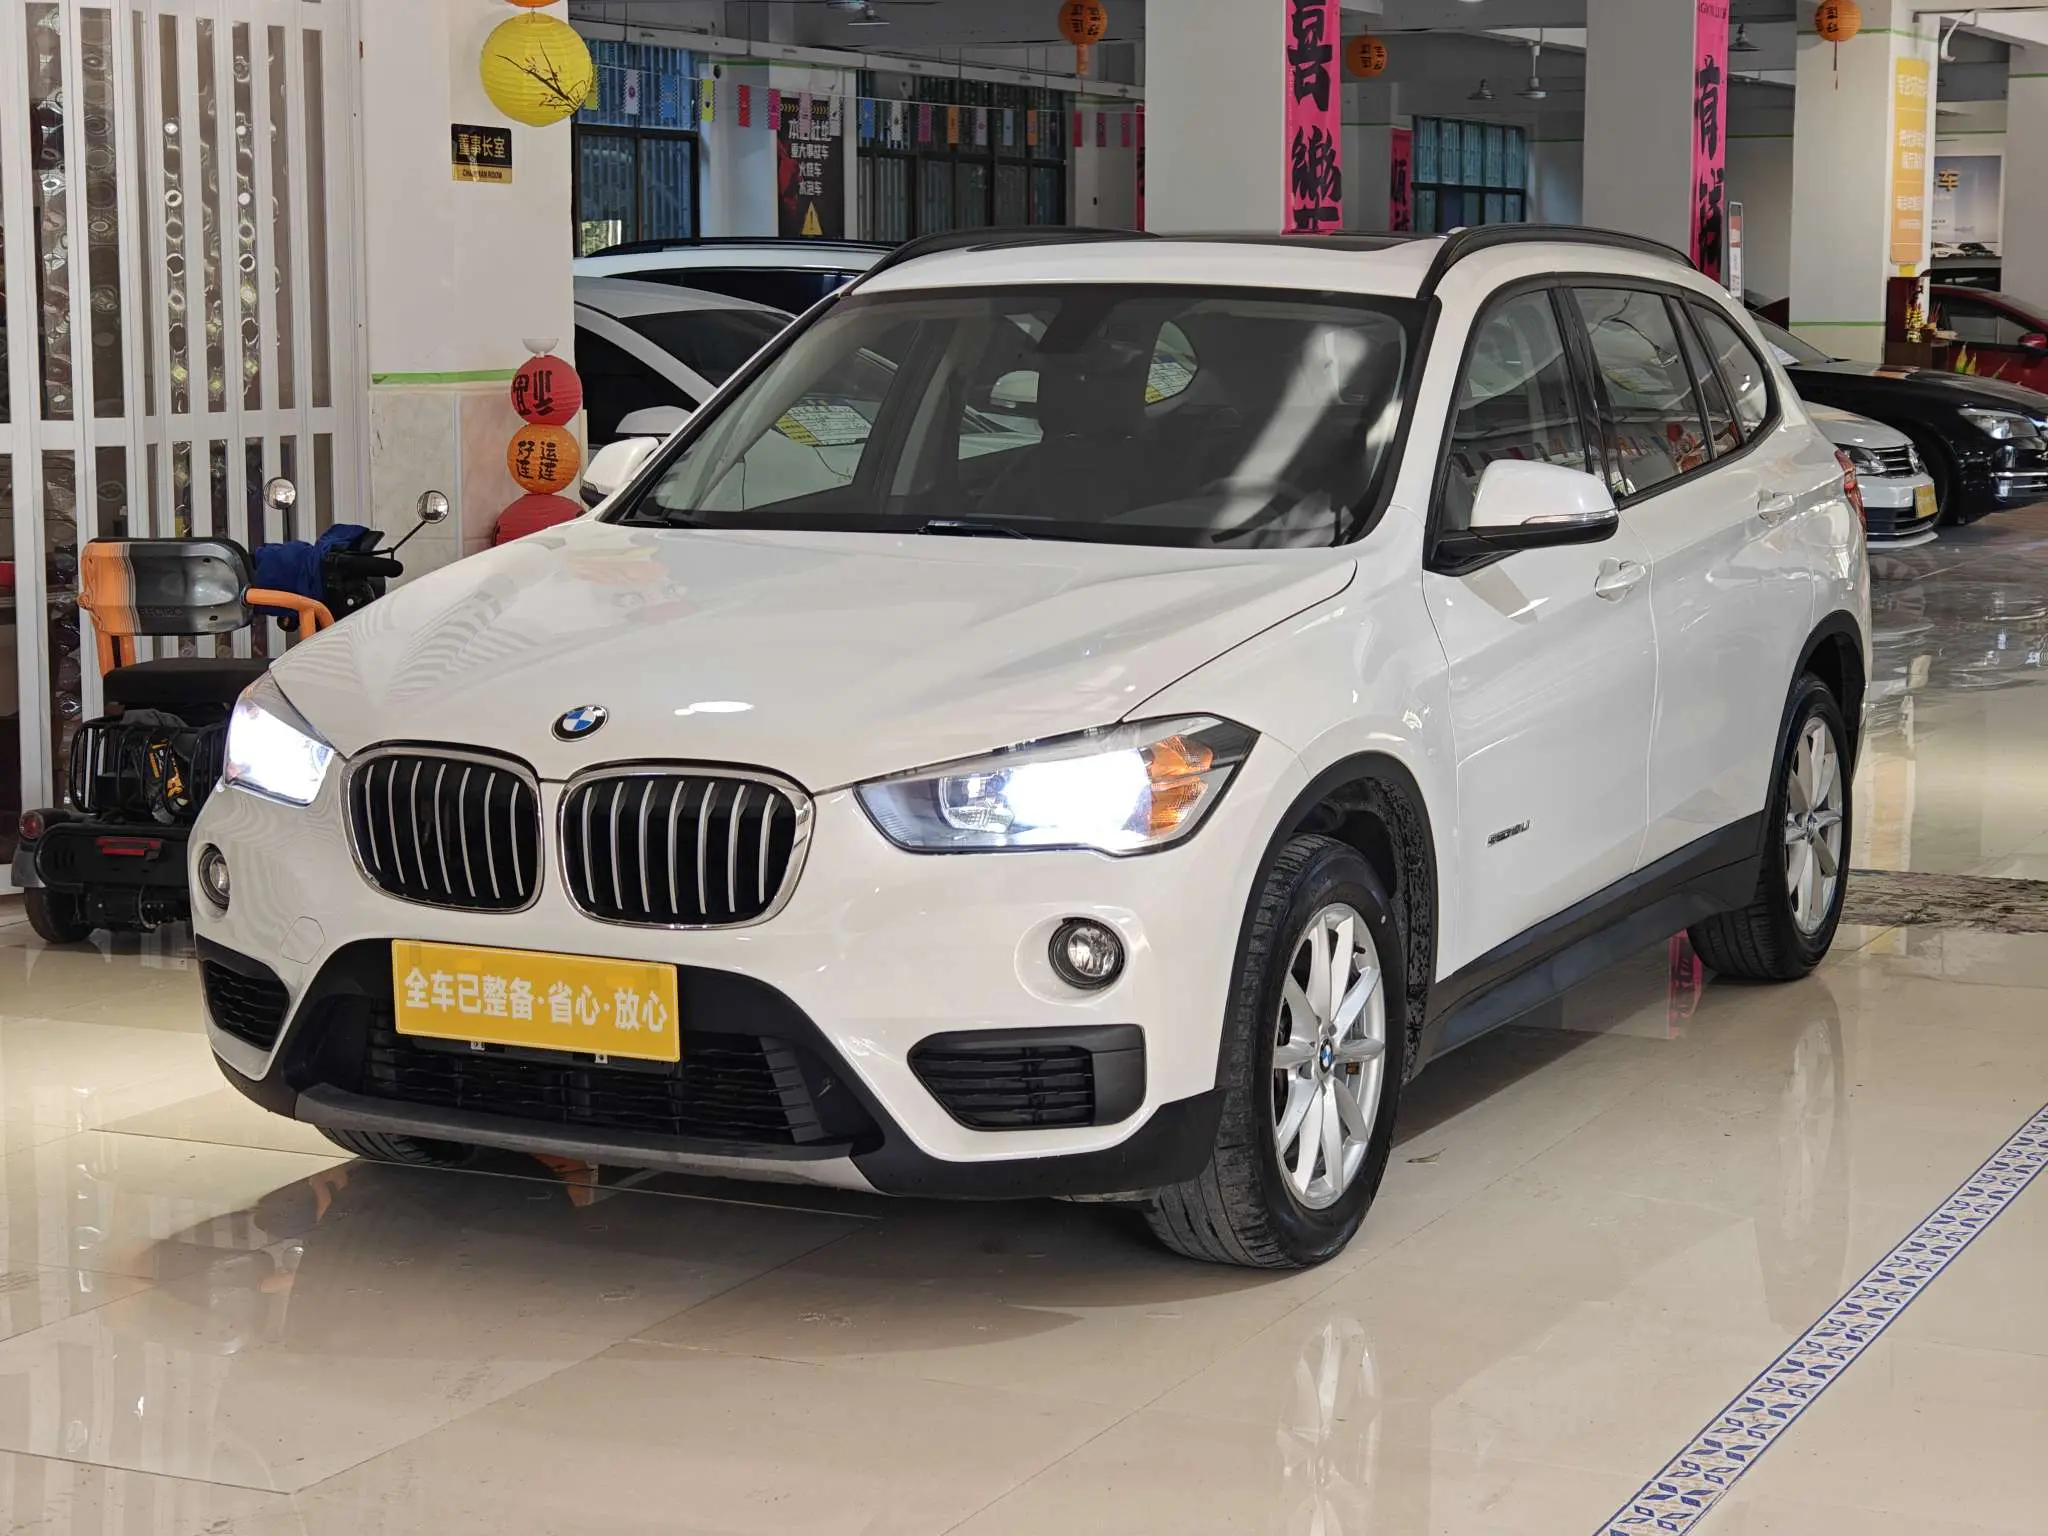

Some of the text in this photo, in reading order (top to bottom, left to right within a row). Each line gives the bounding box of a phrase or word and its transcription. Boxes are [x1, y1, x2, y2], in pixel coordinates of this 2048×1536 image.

[788, 118, 832, 142] 本杜绝
[458, 133, 506, 158] 董事长室
[791, 143, 830, 160] 重大事故车
[798, 161, 823, 177] 火烧车
